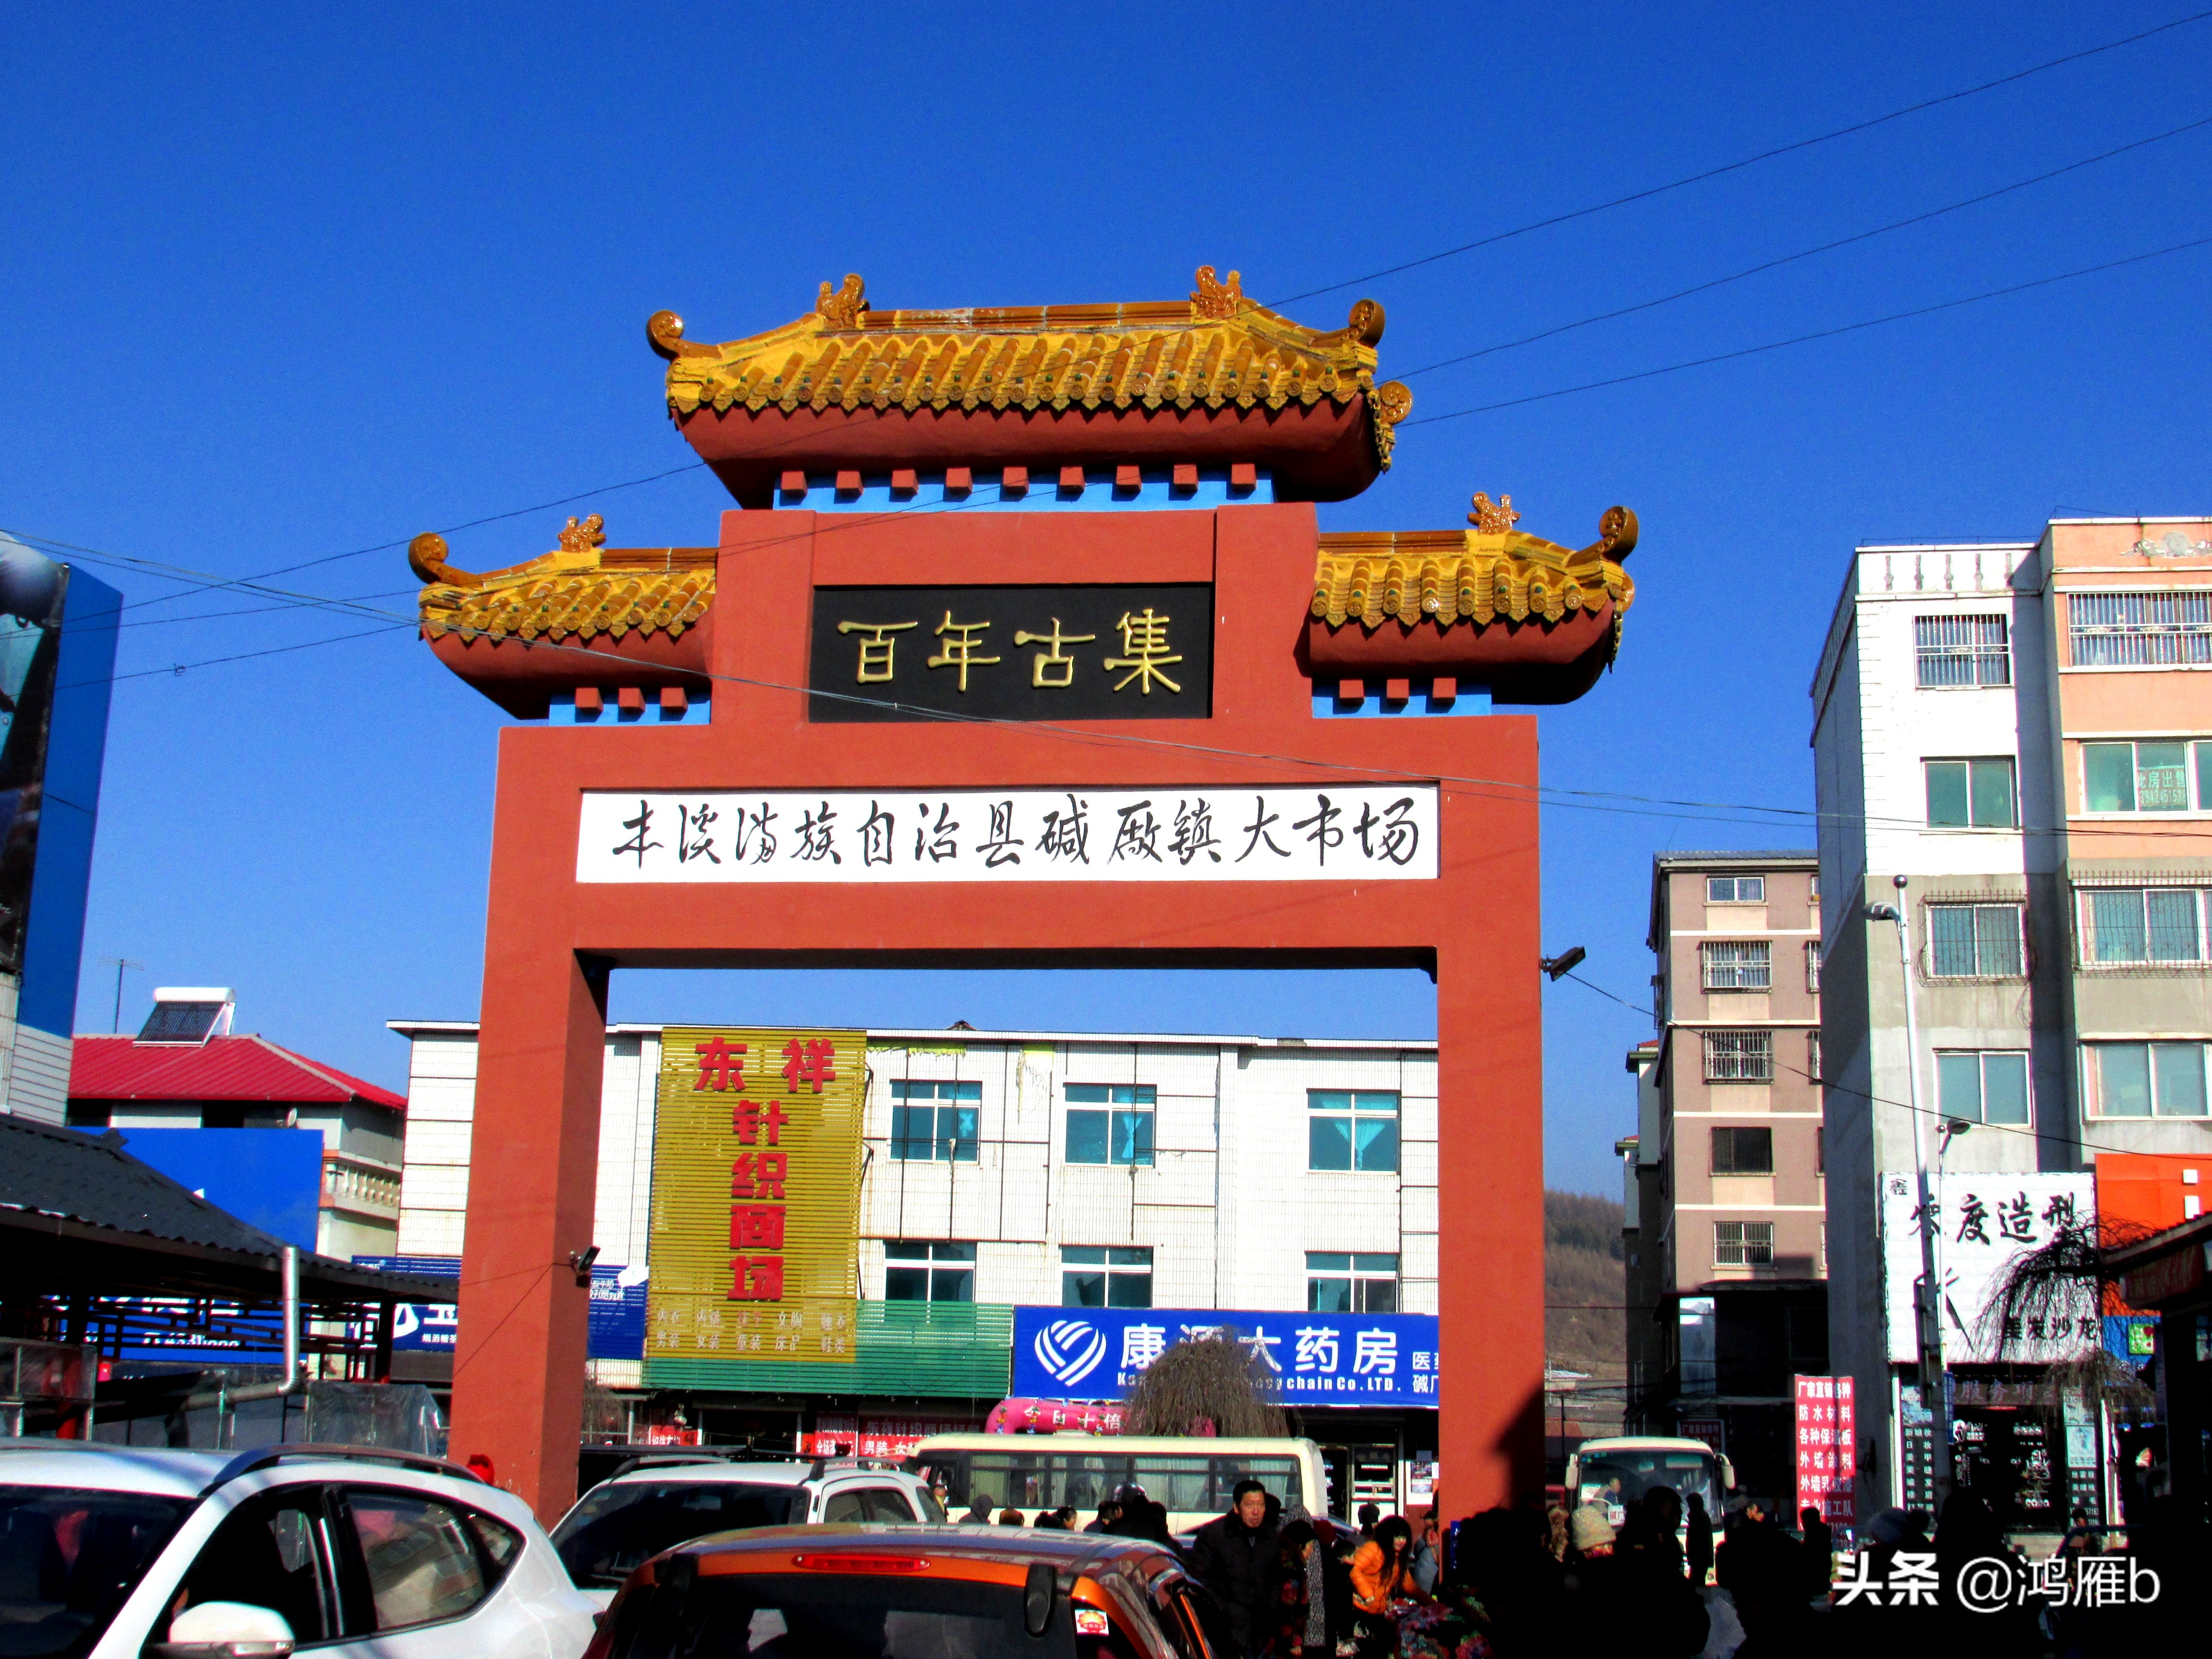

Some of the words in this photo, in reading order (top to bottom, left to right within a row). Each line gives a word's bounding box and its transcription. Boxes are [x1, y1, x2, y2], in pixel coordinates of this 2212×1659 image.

[837, 609, 1183, 694] 百年古集
[695, 1037, 836, 1093] 东祥
[727, 1100, 789, 1300] 针织商场
[657, 1331, 680, 1348] 男装
[697, 1333, 720, 1349] 女装
[737, 1334, 761, 1350] 童装
[776, 1334, 800, 1351] 床品
[1798, 1381, 1851, 1398] 厂家直销各种
[1799, 1405, 1851, 1422] 防水材料
[1799, 1427, 1852, 1445] 各种保温板
[865, 1441, 888, 1455] 男装
[1800, 1451, 1852, 1469] 外墙涂料
[1800, 1475, 1853, 1493] 外墙乳胶漆
